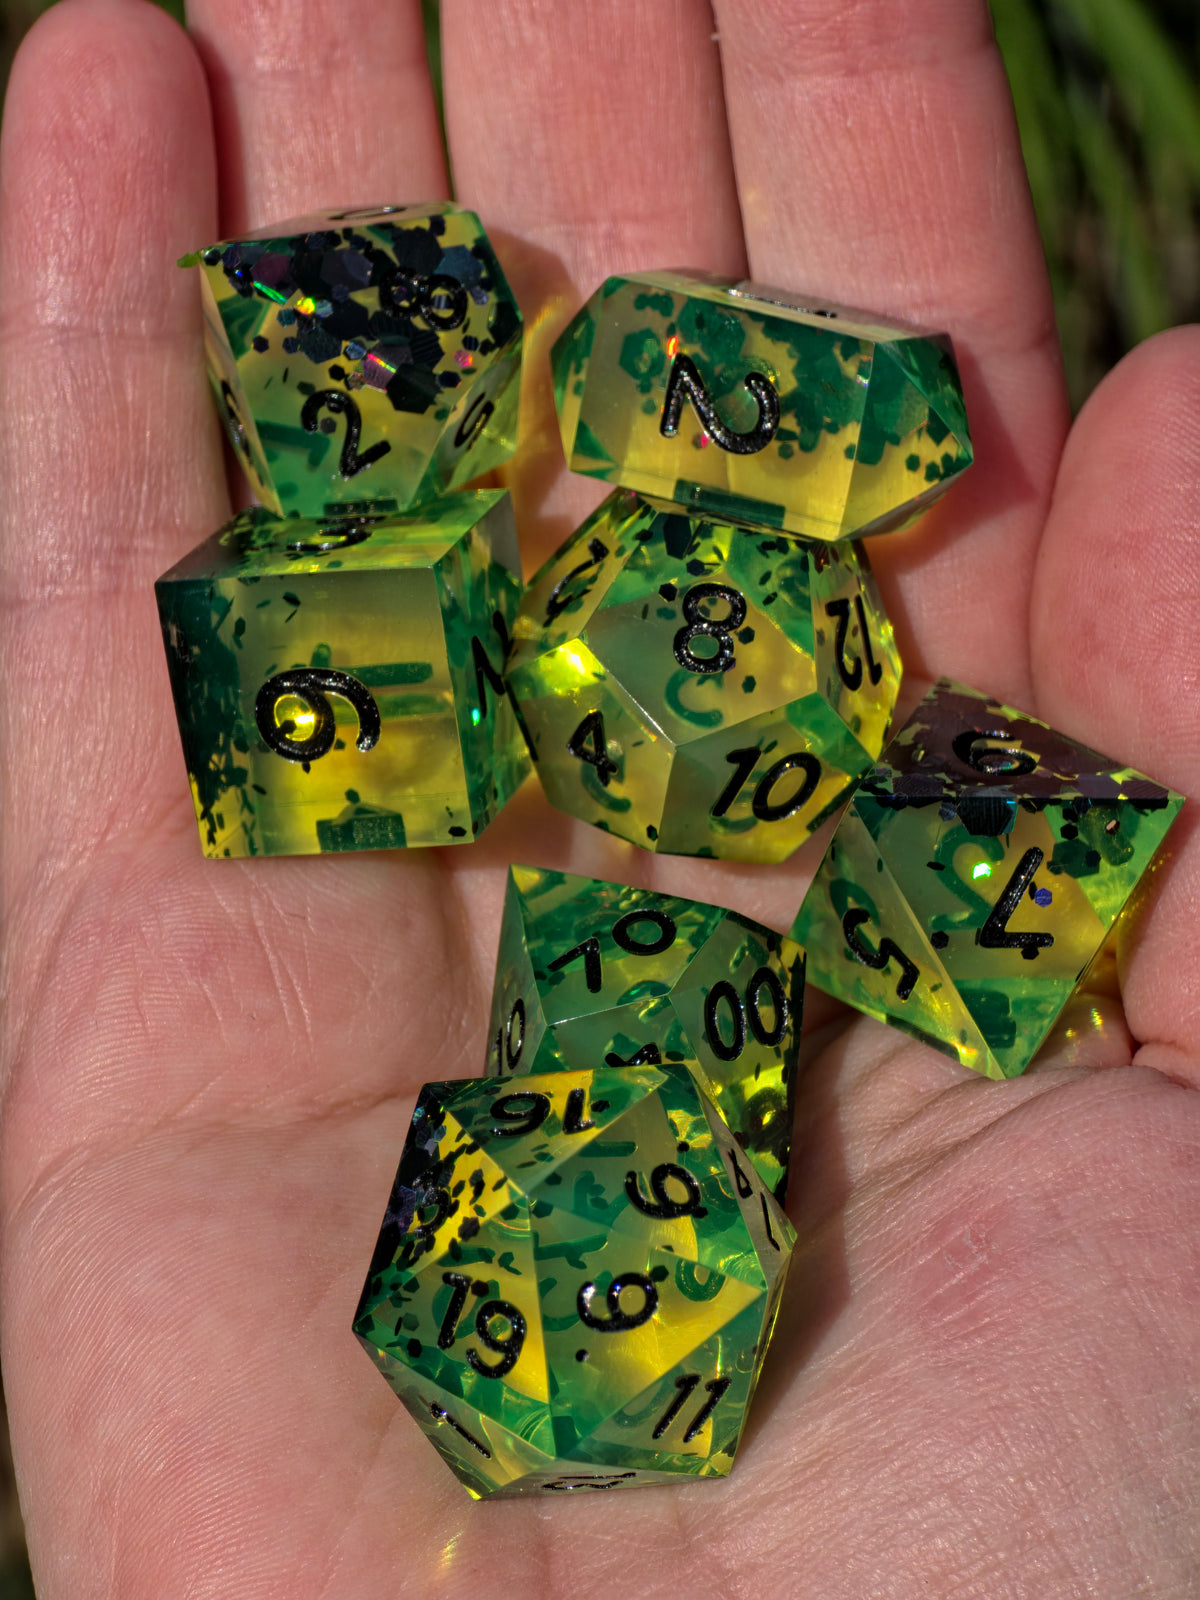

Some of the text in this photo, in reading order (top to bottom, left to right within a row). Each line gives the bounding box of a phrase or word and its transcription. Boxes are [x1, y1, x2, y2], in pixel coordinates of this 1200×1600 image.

[379, 267, 468, 330] 8
[301, 389, 392, 479] 2
[660, 352, 780, 456] 2
[673, 582, 747, 674] 8
[826, 595, 883, 691] 12
[567, 710, 617, 787] 4
[709, 746, 822, 822] 10
[951, 729, 1037, 777] 6
[979, 846, 1054, 948] 7
[547, 908, 677, 994] 70
[842, 908, 921, 1001] 5
[704, 967, 788, 1062] 00
[489, 1091, 595, 1137] 16
[437, 1272, 528, 1379] 19
[651, 1374, 733, 1443] 11
